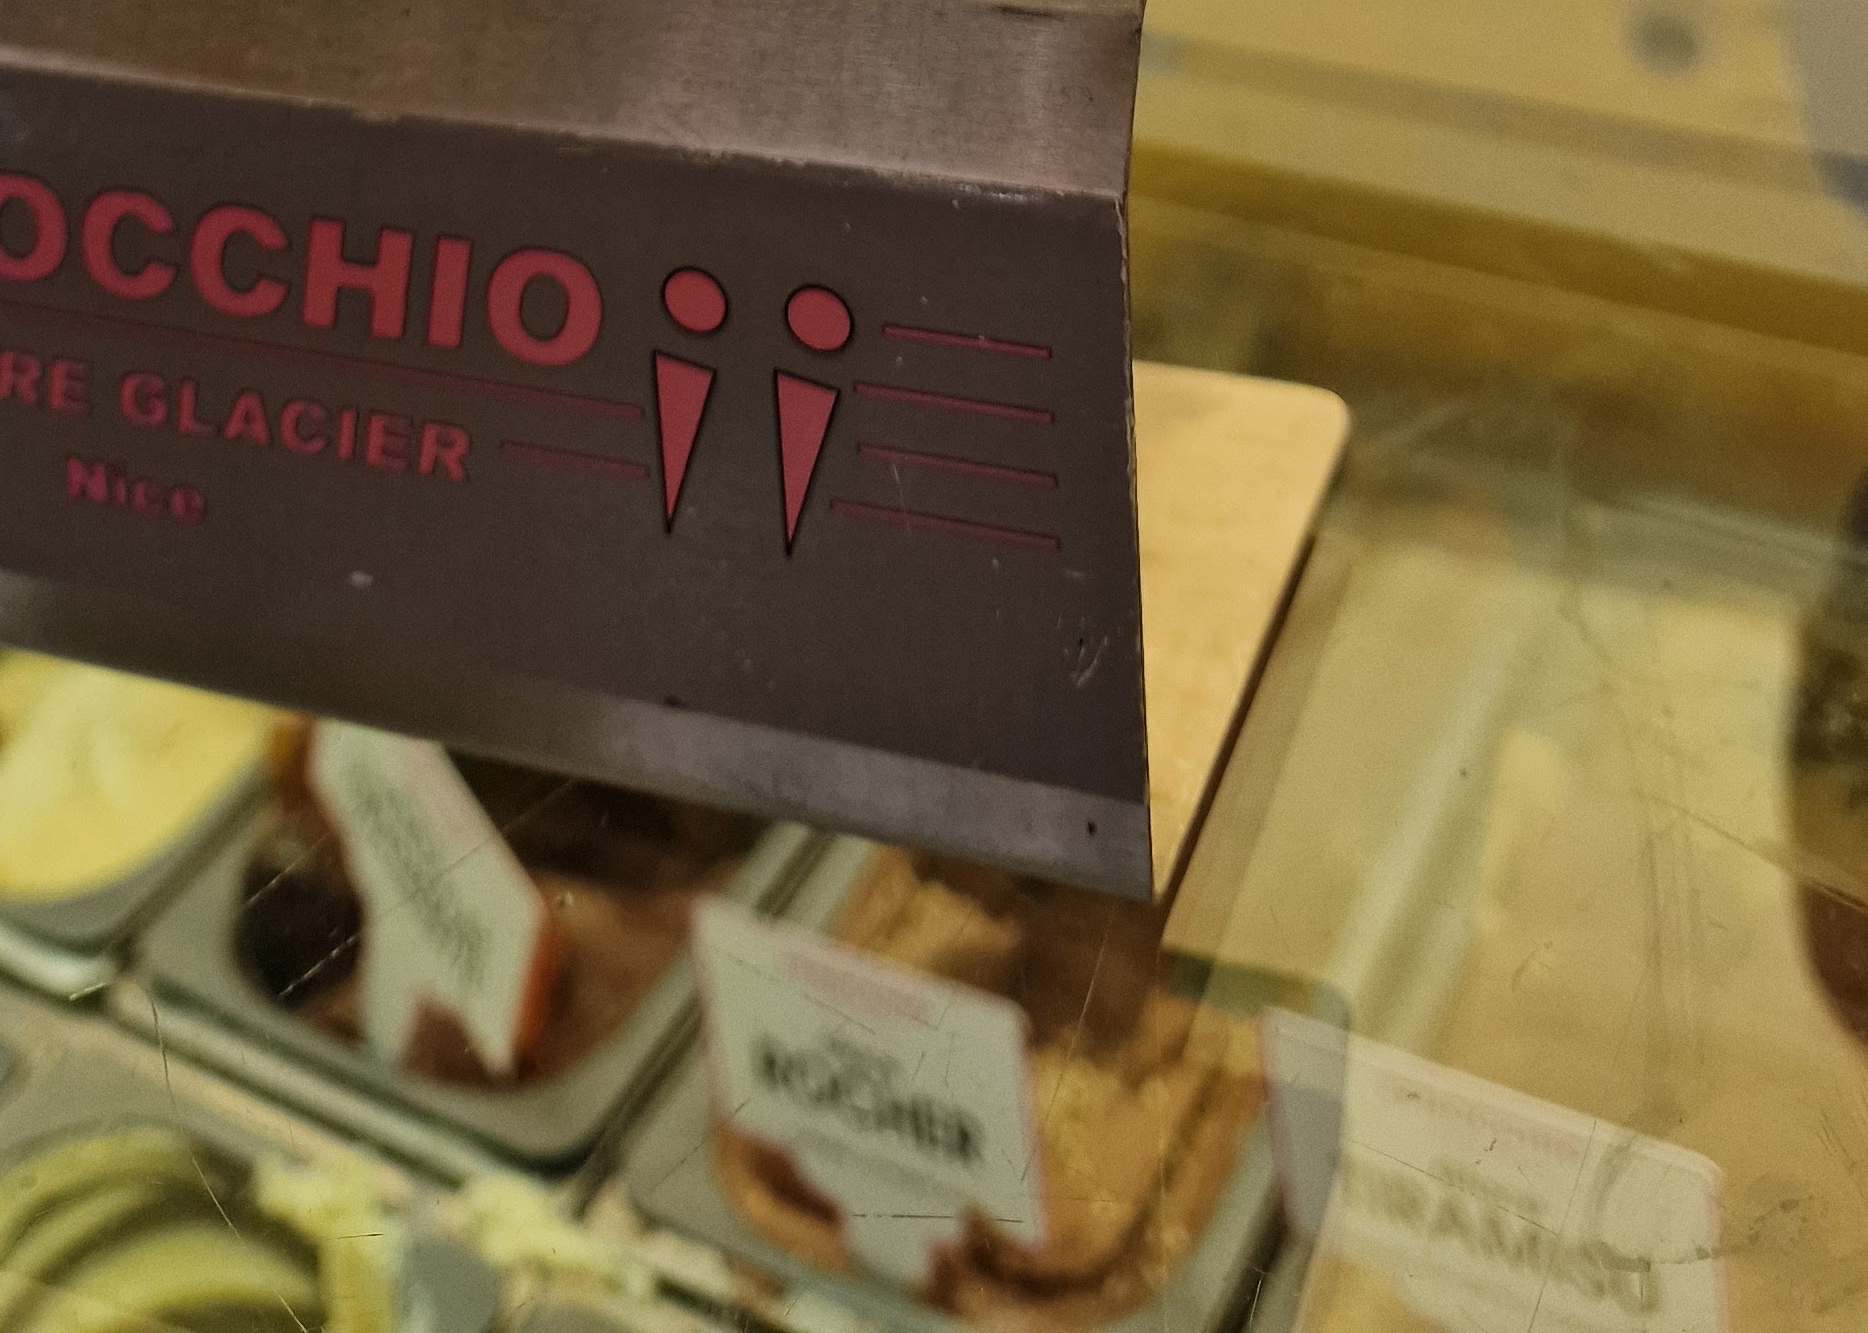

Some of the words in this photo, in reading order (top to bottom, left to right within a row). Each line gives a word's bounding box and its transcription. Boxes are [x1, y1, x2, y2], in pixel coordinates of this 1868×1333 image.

[0, 173, 602, 367] OCCHIO
[119, 370, 471, 482] GLACIER
[65, 455, 205, 526] Nice
